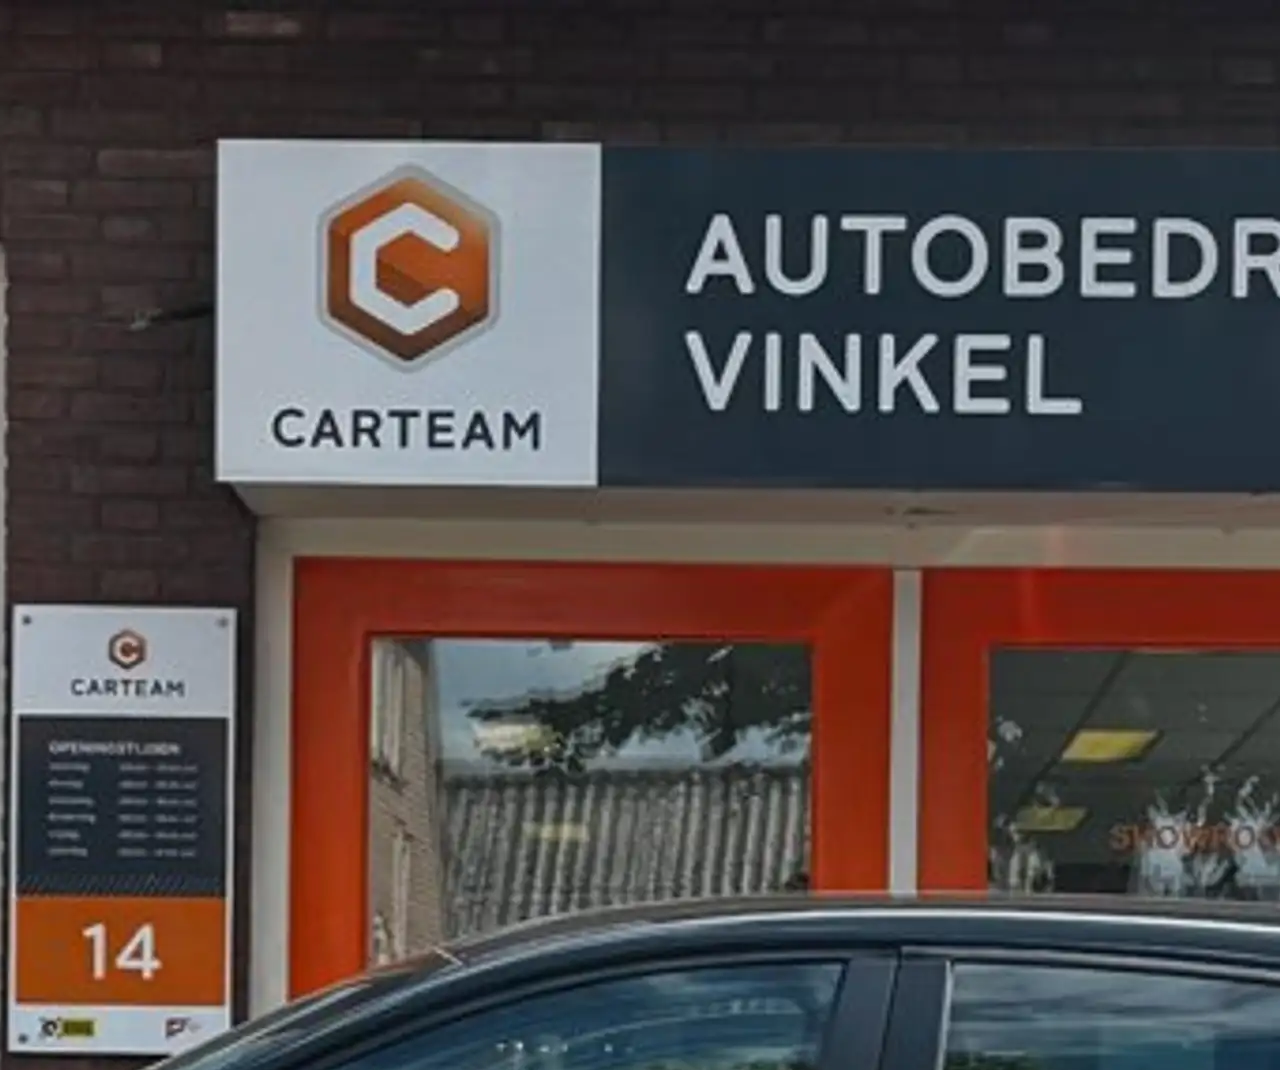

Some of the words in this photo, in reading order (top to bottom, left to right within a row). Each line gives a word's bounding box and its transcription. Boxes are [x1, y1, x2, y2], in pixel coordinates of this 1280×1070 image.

[685, 330, 1083, 415] VINKEL
[271, 407, 542, 451] CARTEAM
[70, 678, 186, 698] CARTEAM
[82, 922, 163, 981] 14
